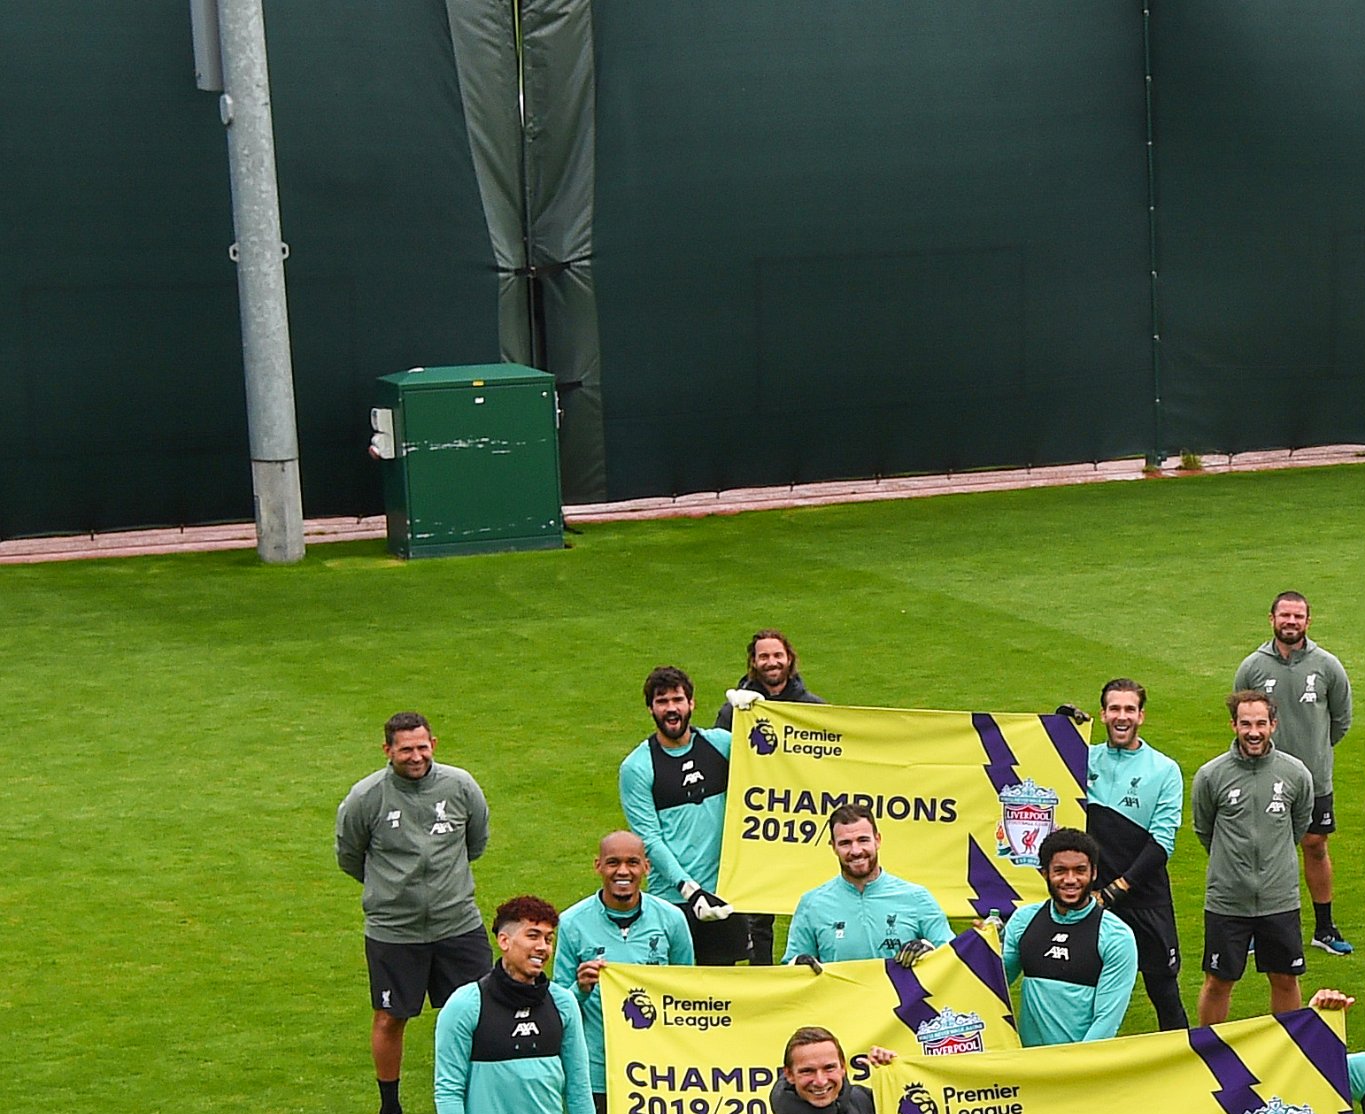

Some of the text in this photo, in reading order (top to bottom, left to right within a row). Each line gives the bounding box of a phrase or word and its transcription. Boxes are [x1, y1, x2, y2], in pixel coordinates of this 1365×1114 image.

[784, 726, 843, 742] Premier
[784, 742, 842, 759] League
[682, 771, 704, 786] AXA
[1117, 796, 1140, 808] AXA
[1006, 811, 1052, 821] LIVERPOOL
[878, 938, 902, 950] AXA
[1044, 946, 1069, 961] AXA
[663, 995, 731, 1011] Premier
[664, 1012, 731, 1031] League
[512, 1022, 540, 1037] AXA
[943, 1084, 1020, 1104] Premier
